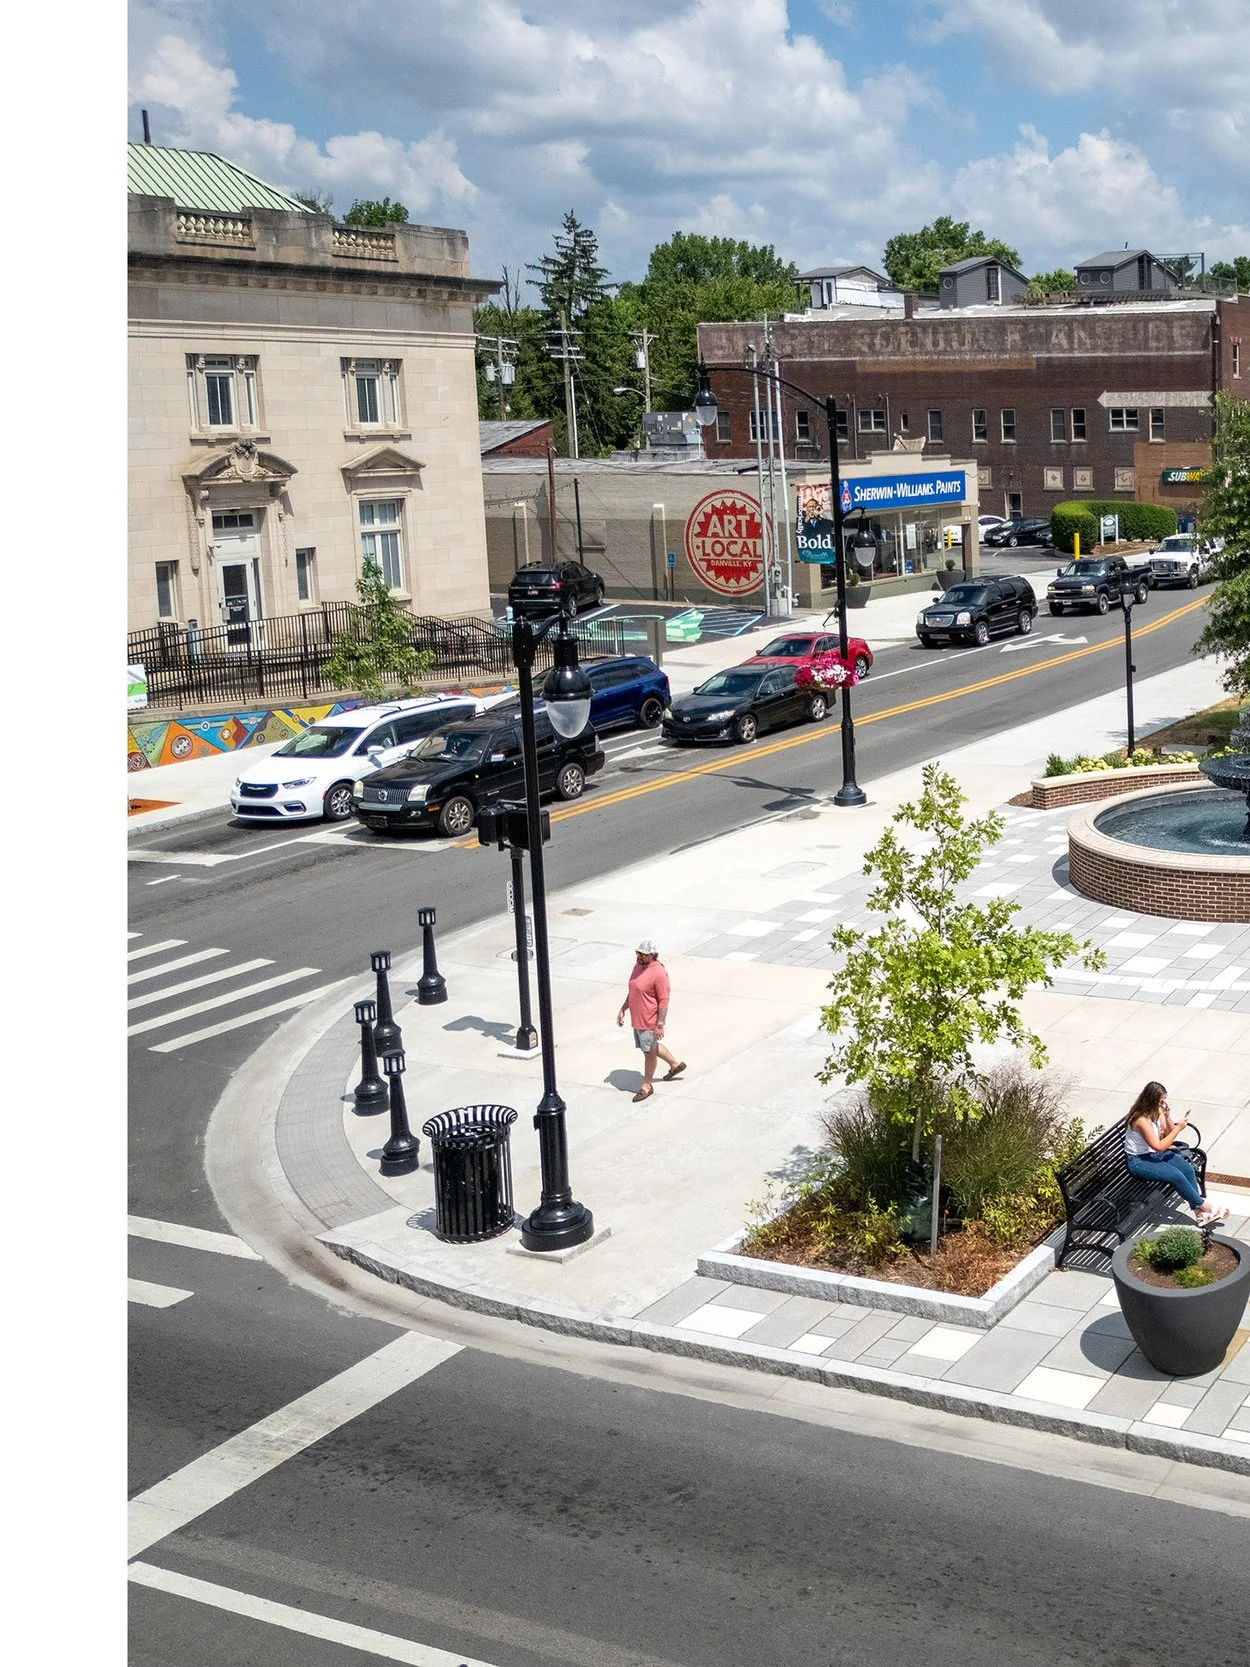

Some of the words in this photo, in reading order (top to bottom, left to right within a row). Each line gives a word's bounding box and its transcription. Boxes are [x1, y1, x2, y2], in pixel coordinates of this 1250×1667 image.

[936, 480, 961, 494] PAINTS
[706, 514, 750, 538] ART
[701, 539, 762, 558] LOCAL
[796, 534, 833, 550] Bold
[743, 560, 752, 568] KY
